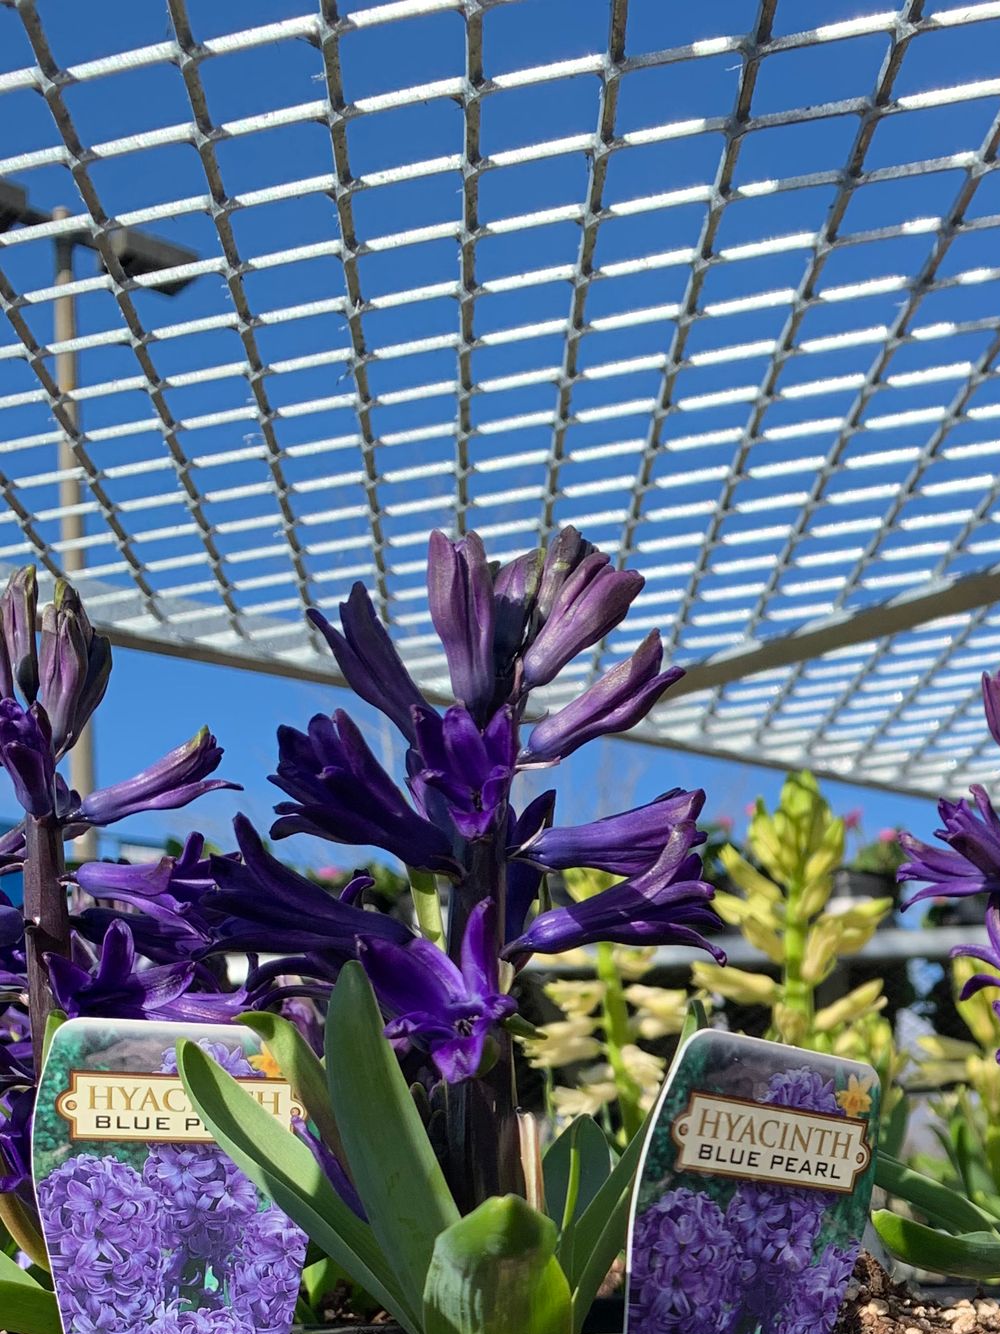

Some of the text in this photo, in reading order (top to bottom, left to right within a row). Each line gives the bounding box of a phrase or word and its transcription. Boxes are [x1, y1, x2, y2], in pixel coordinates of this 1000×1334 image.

[87, 1084, 281, 1115] HYACH
[95, 1115, 171, 1131] BLUE
[696, 1108, 854, 1160] HYACINTH
[698, 1144, 841, 1179] BLUE PEARL
